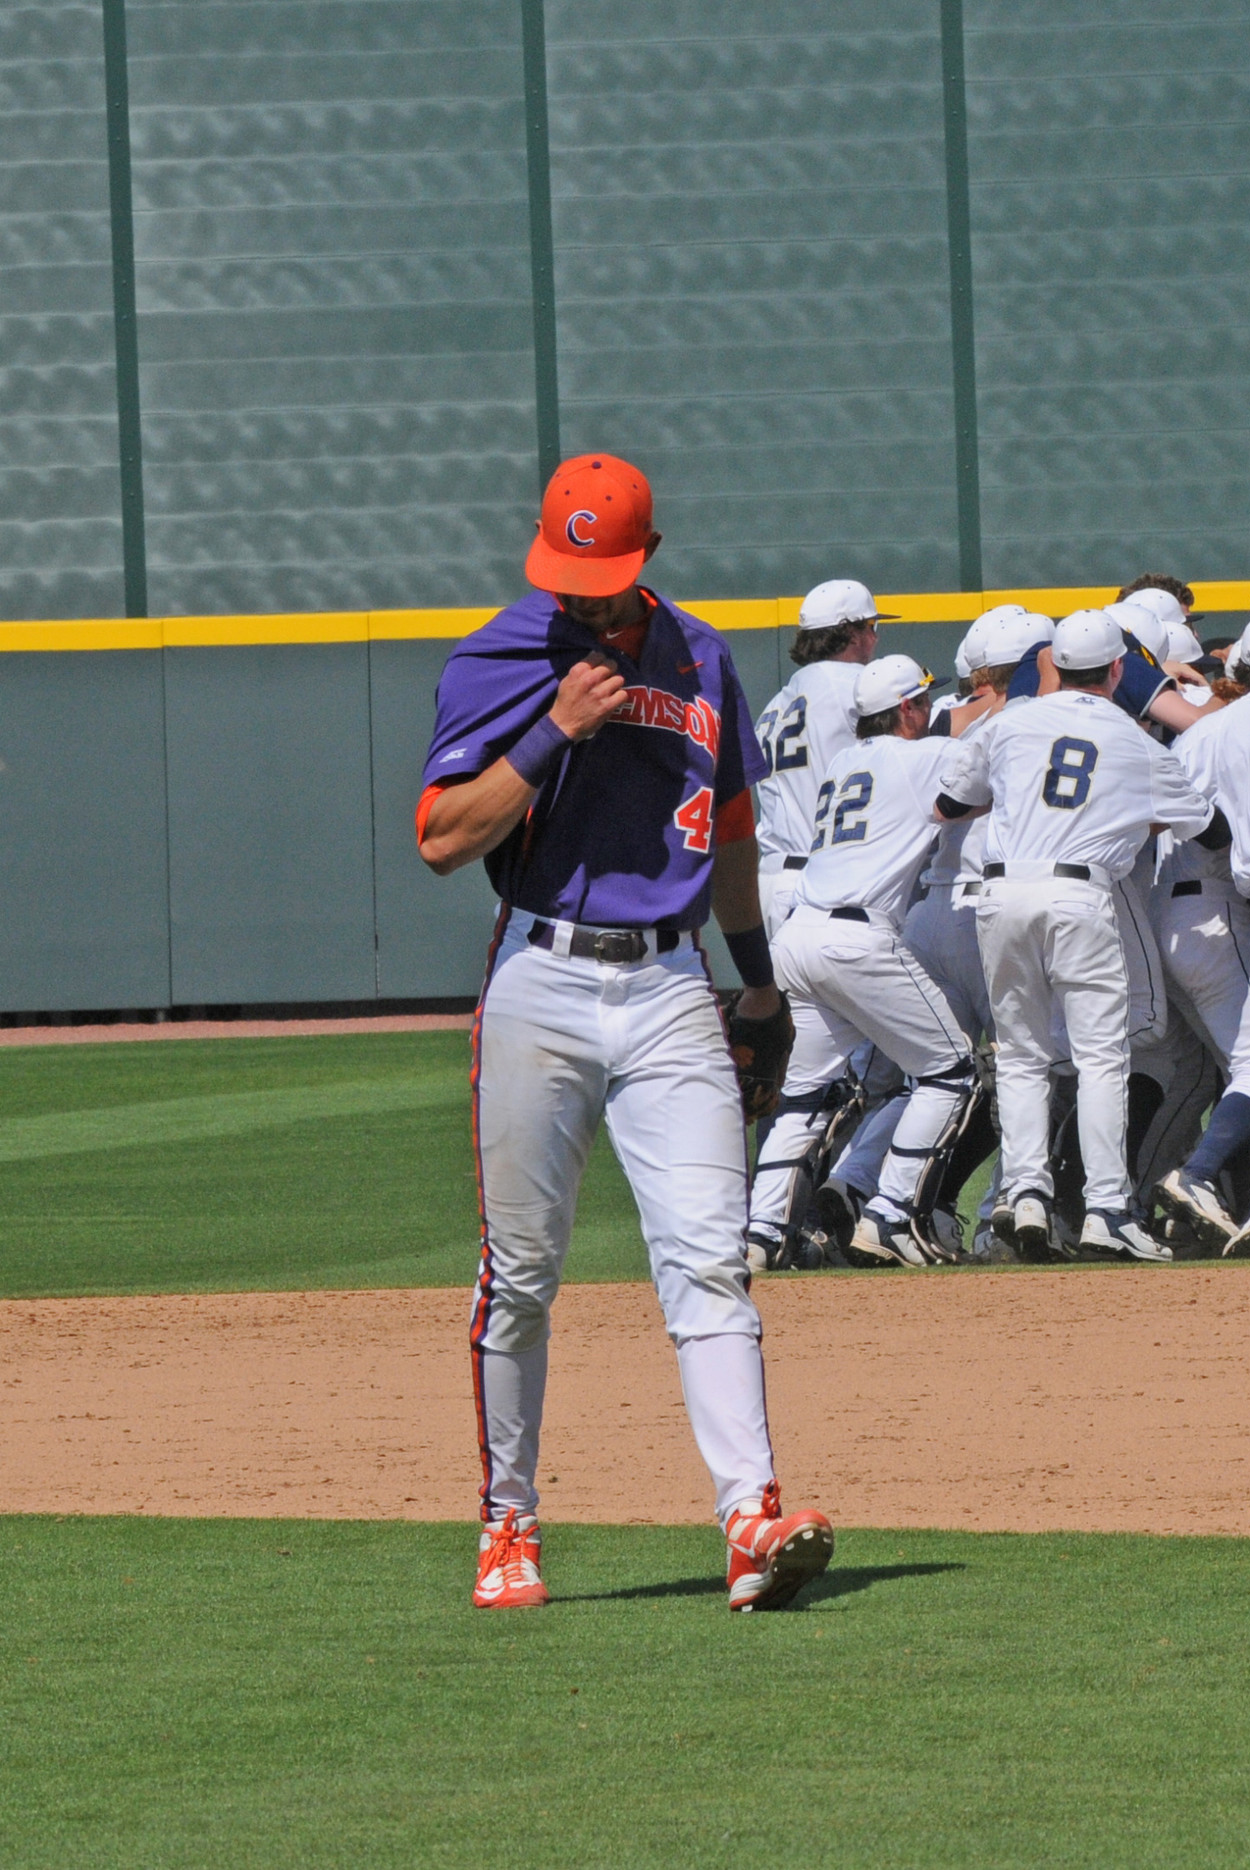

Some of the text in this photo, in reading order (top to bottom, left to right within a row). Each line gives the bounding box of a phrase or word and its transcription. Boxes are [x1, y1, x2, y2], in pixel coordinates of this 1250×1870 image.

[566, 509, 597, 549] C
[1041, 734, 1100, 812] 8
[673, 786, 713, 853] 4
[811, 770, 875, 855] 22
